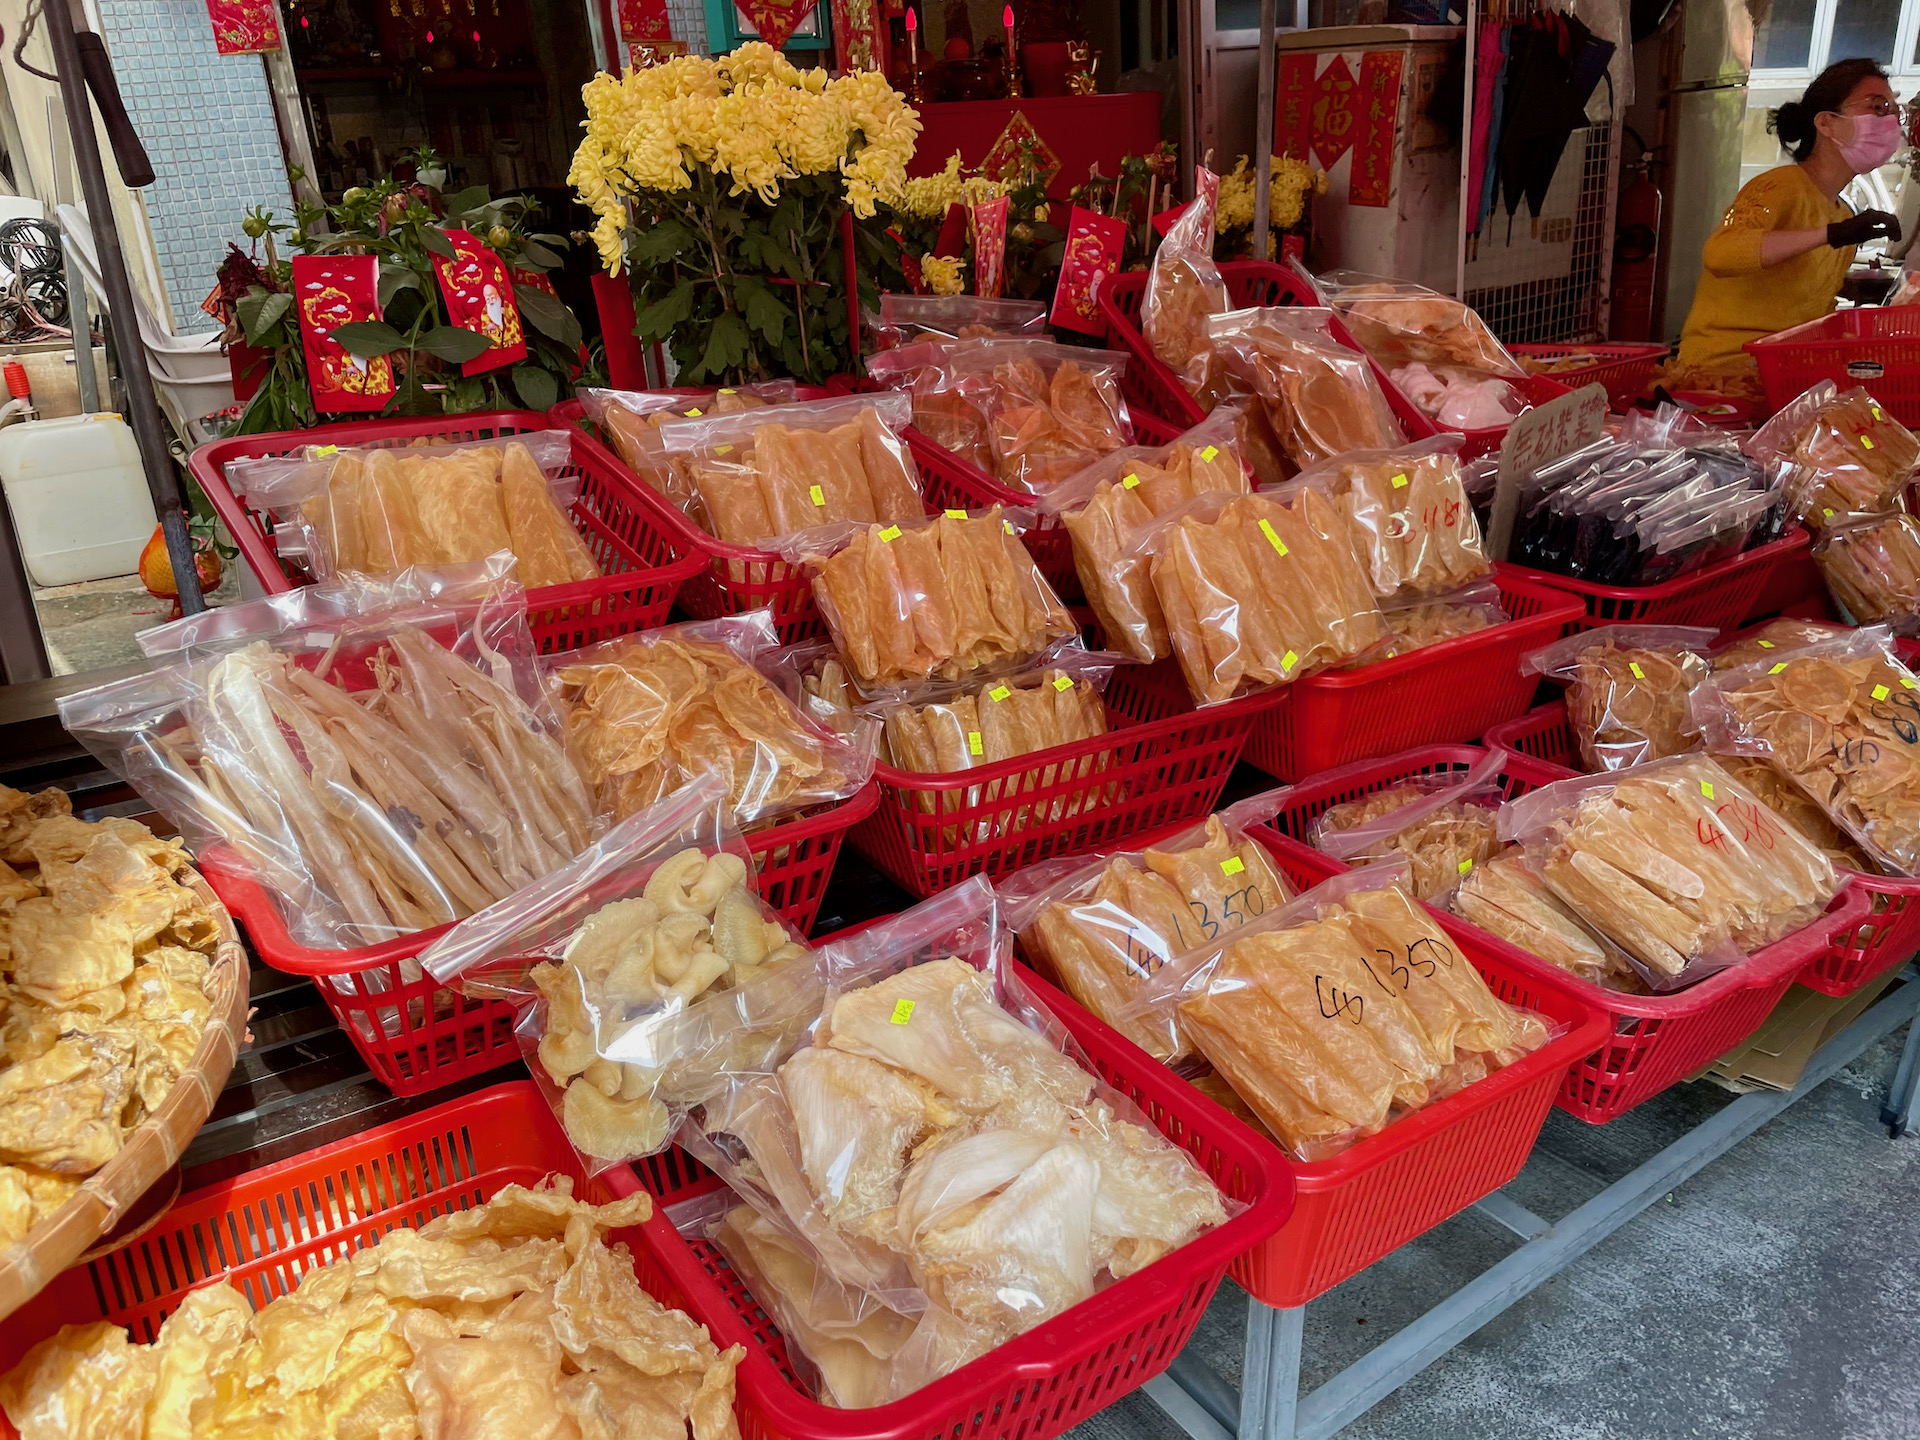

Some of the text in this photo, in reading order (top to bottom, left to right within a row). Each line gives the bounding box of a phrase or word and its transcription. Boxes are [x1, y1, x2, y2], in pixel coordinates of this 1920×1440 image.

[1312, 79, 1353, 136] 福
[1364, 68, 1389, 178] 新春大吉
